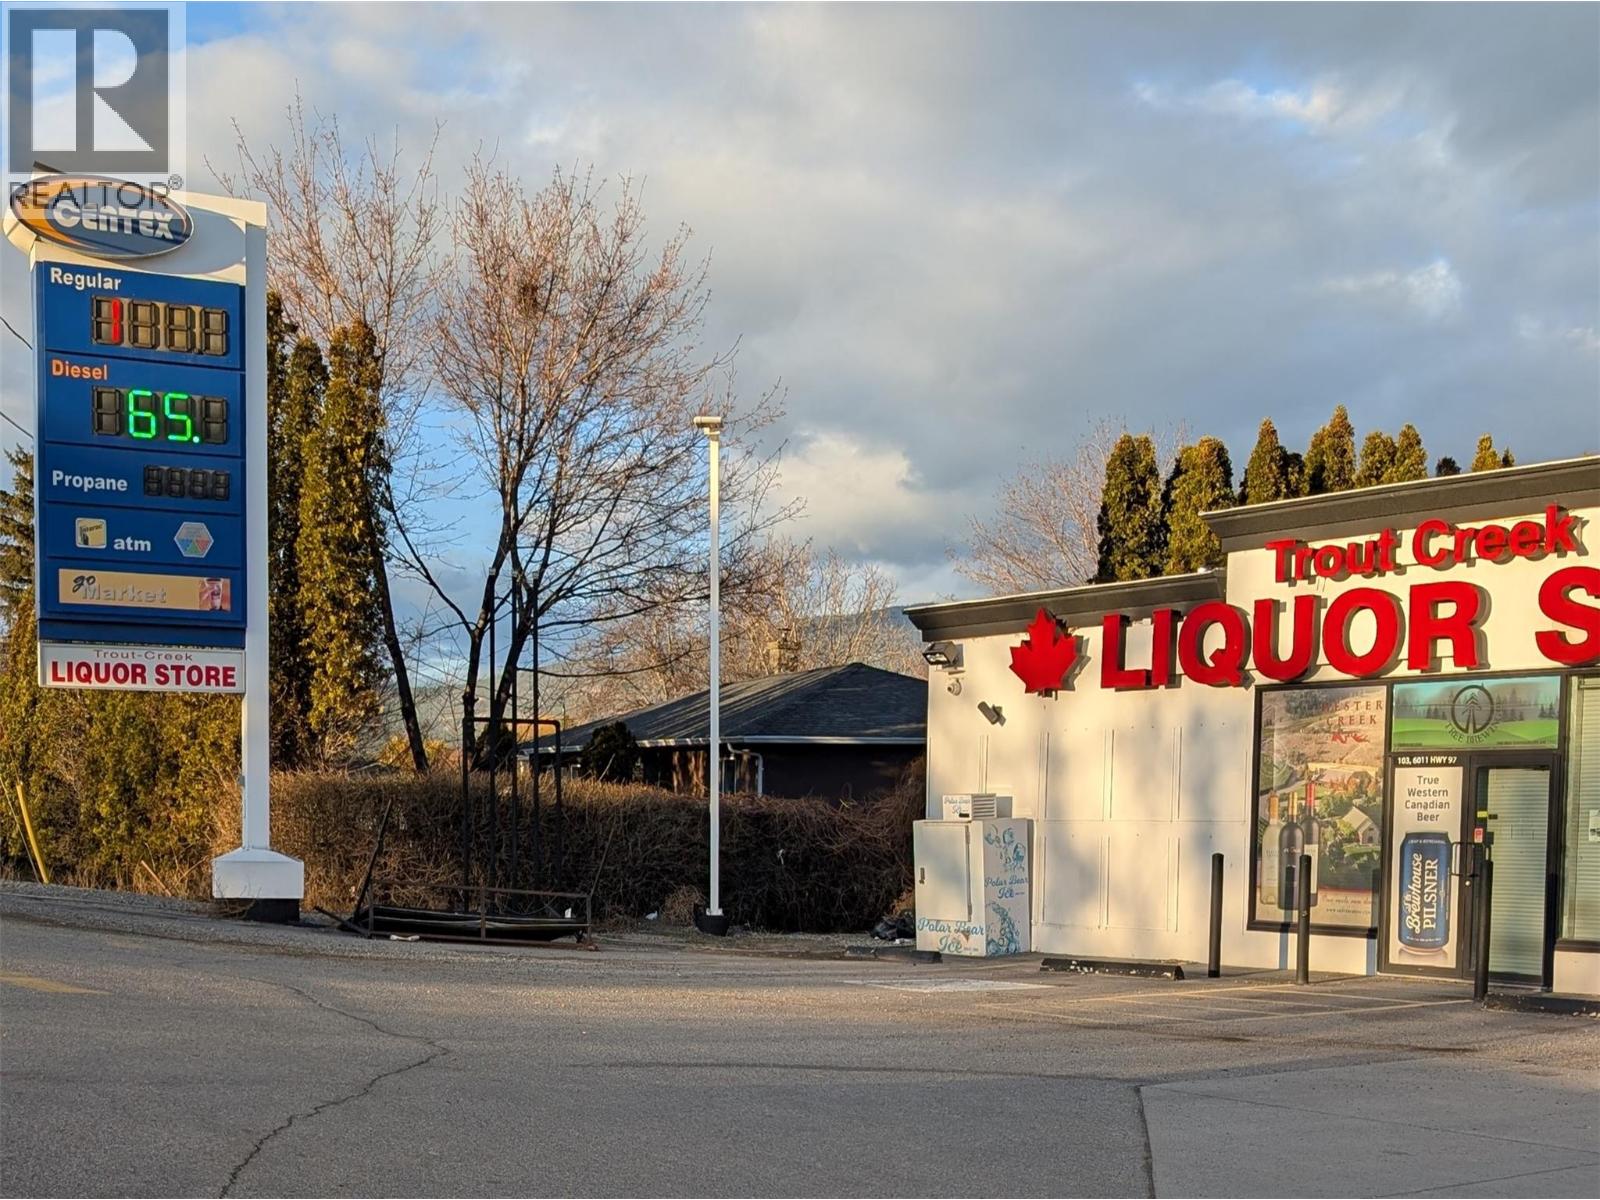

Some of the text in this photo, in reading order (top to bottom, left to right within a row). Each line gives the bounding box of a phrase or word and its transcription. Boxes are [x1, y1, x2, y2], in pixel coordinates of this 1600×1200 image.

[50, 267, 121, 290] Regular
[51, 359, 108, 380] Diesel
[52, 470, 128, 492] Propane
[113, 536, 151, 552] atm
[1265, 503, 1583, 584] Trout Creek
[72, 575, 96, 593] go
[82, 583, 167, 604] Market
[1100, 581, 1479, 688] LIQUOR
[51, 661, 236, 687] LIQUOR STORE
[1326, 715, 1377, 726] CREEK
[1430, 756, 1447, 764] HWY
[1448, 756, 1457, 764] 97
[1417, 775, 1440, 785] True
[1407, 787, 1449, 798] Western
[1405, 800, 1450, 811] Canadian
[1416, 812, 1440, 822] Beer
[1406, 852, 1423, 934] Brewhouse
[1423, 858, 1439, 930] PILSNER
[917, 917, 985, 936] Polar Bear
